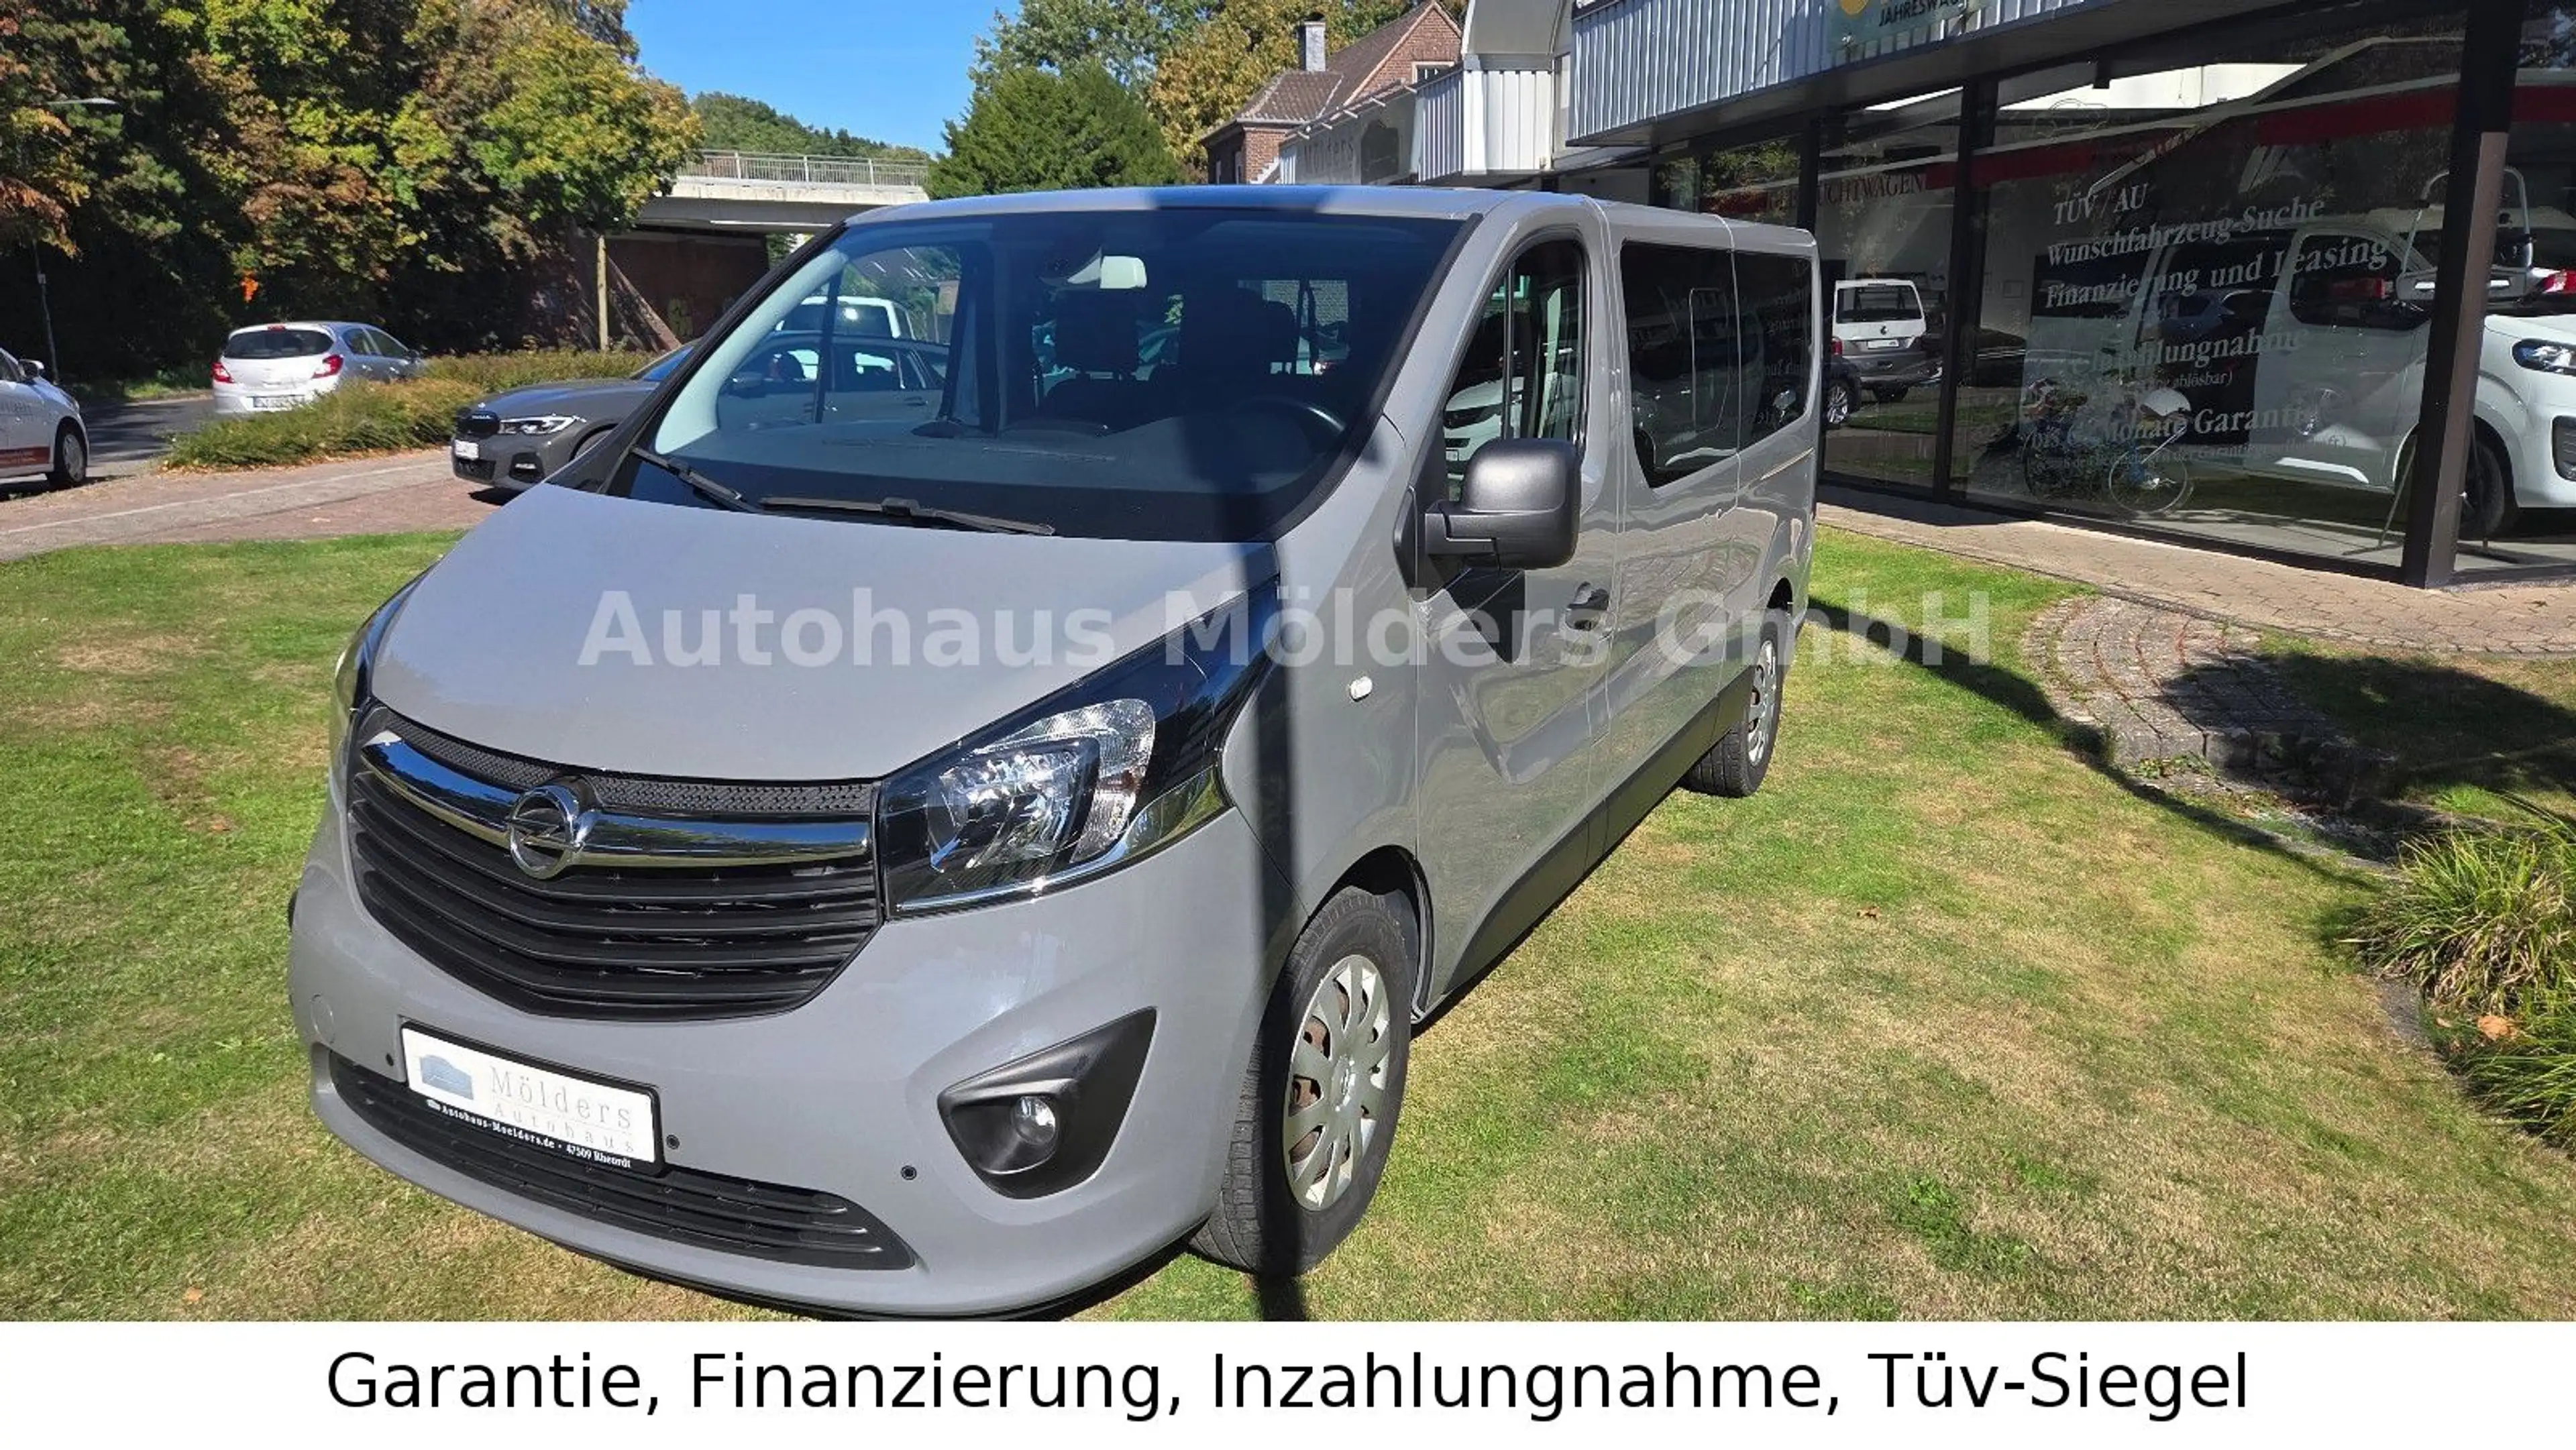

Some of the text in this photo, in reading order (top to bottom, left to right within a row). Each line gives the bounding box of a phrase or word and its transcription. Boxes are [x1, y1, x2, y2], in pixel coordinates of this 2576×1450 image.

[1878, 0, 1960, 27] JAHRESW
[2053, 192, 2098, 225] TÜV
[2113, 182, 2149, 213] AU
[2047, 195, 2326, 267] Wunschfahrzeug-Suche
[2045, 237, 2388, 309] Finanzieng und Leasing
[2194, 404, 2312, 435] Garanti
[490, 1065, 631, 1129] Mölders
[441, 1105, 555, 1148] Autohaus-Moelders.de
[566, 1144, 593, 1160] 47509
[494, 1103, 634, 1152] Autohaus
